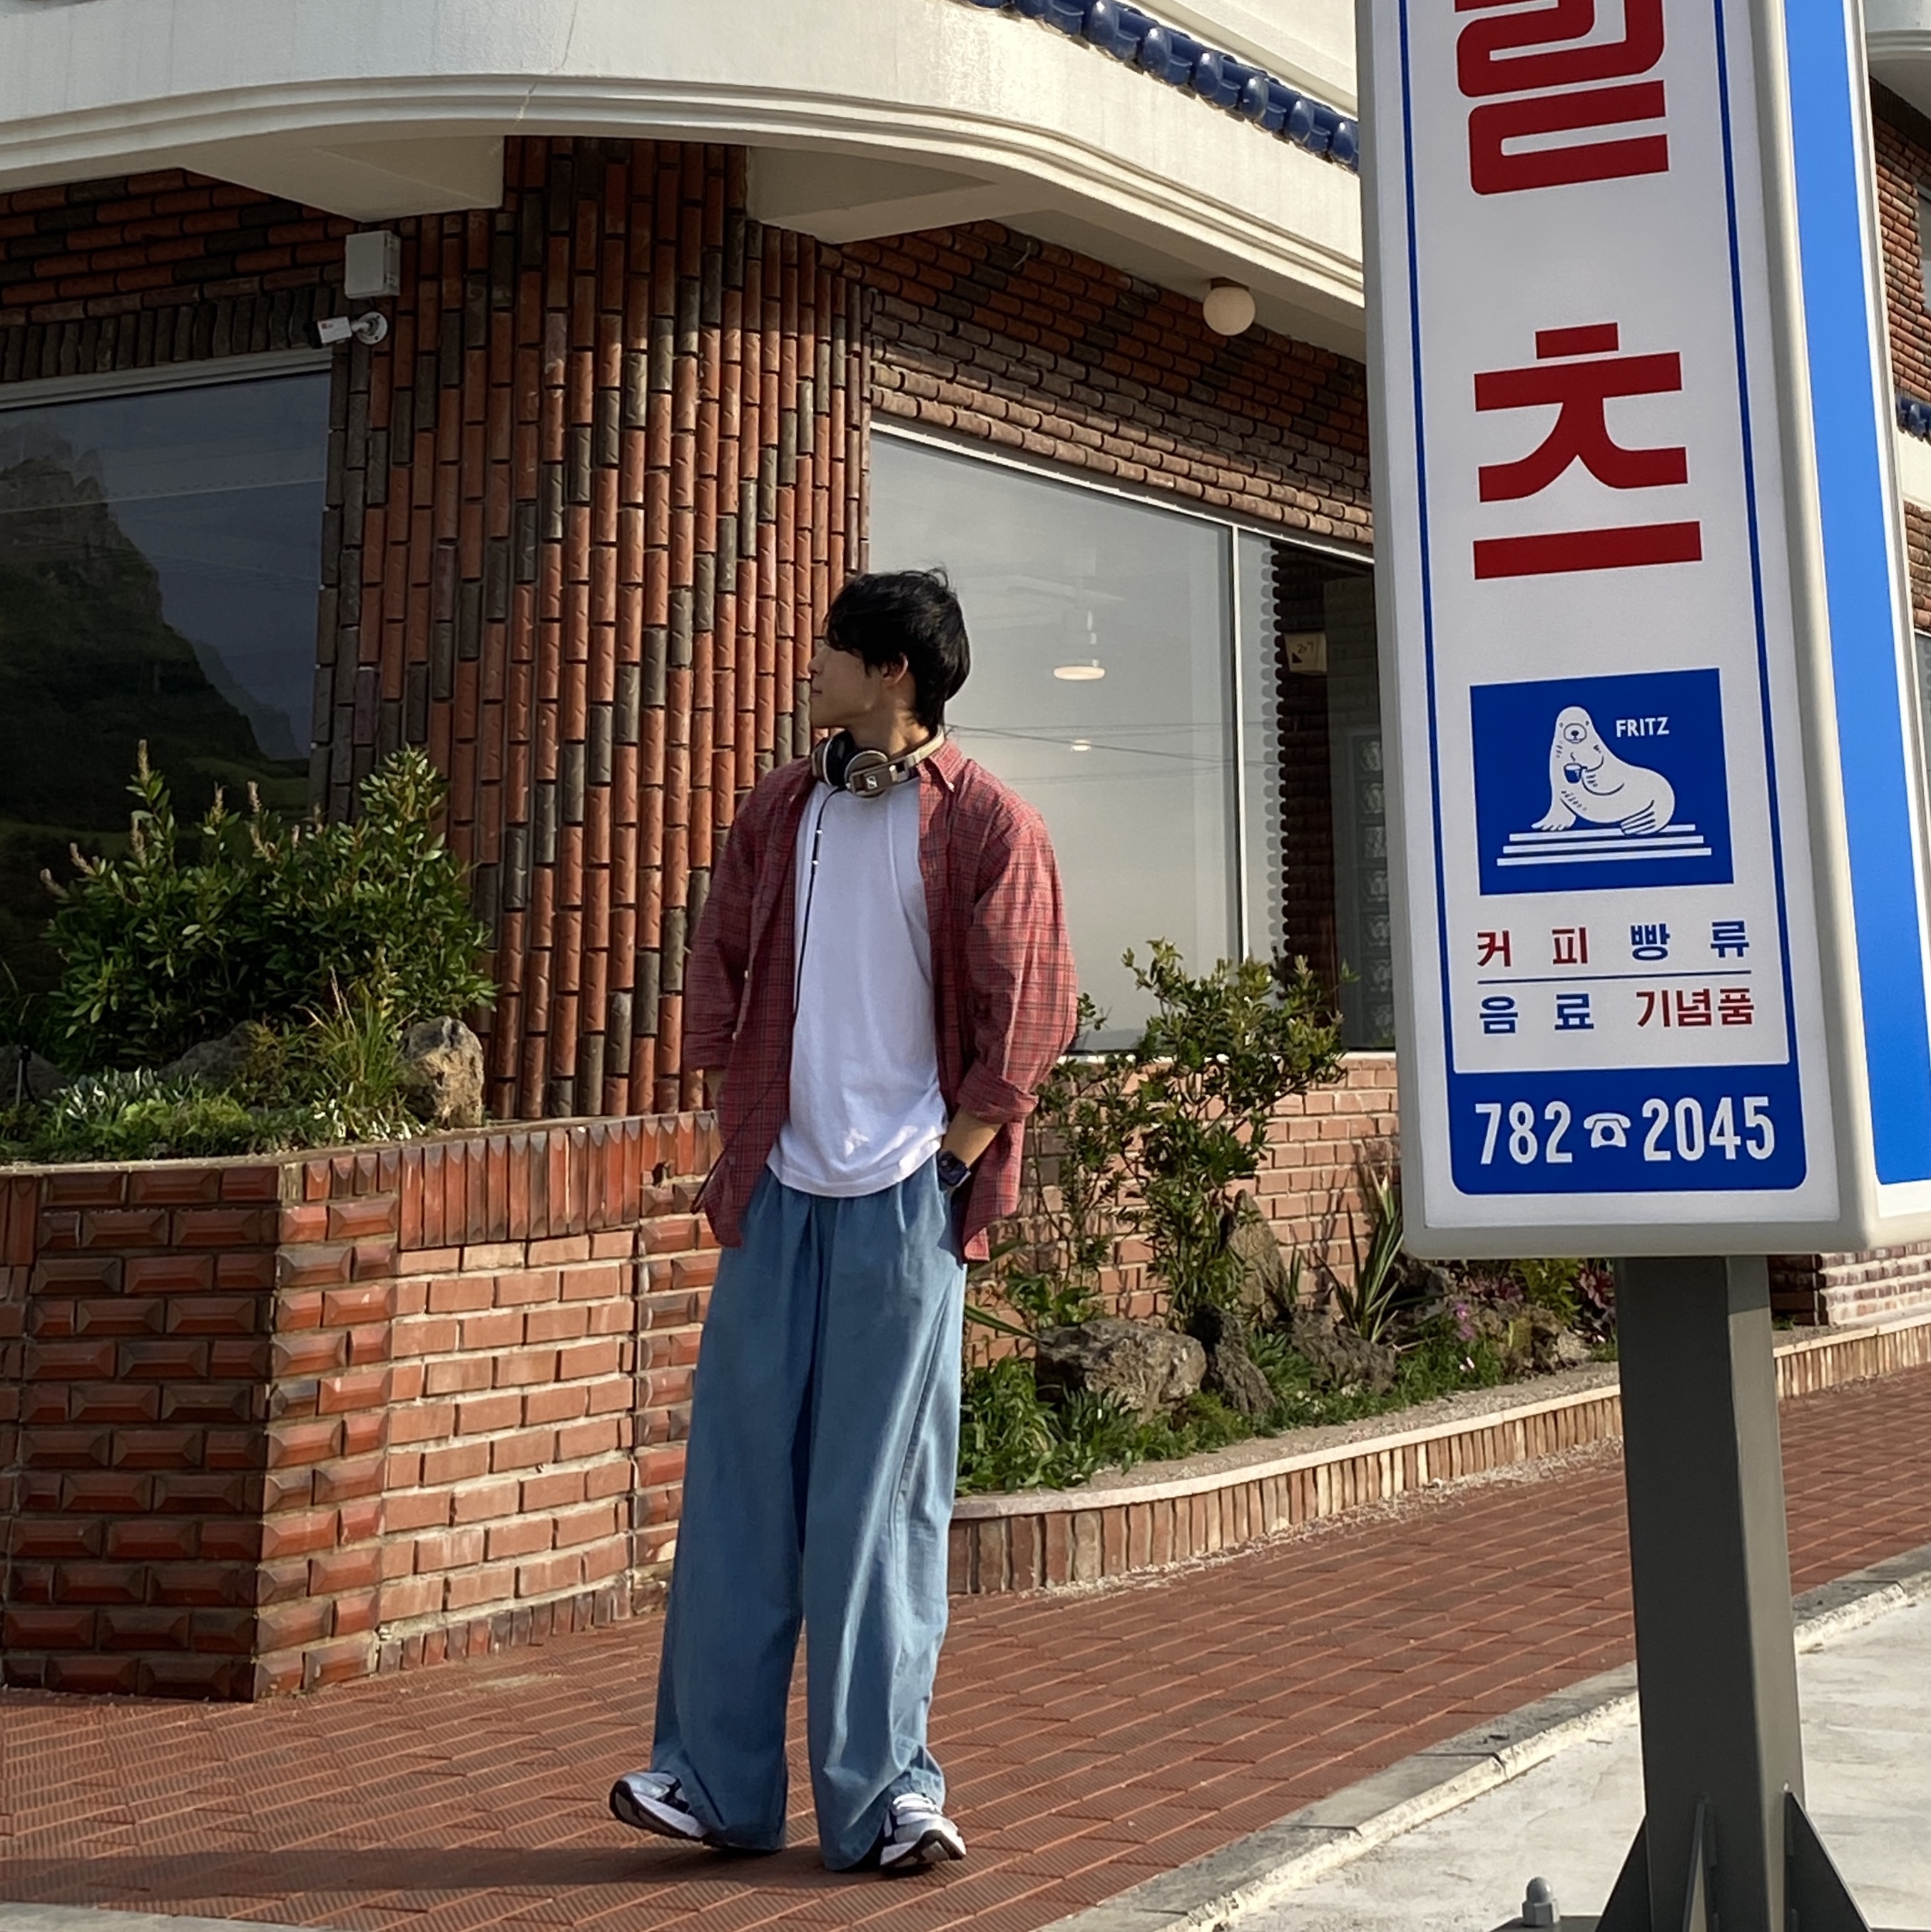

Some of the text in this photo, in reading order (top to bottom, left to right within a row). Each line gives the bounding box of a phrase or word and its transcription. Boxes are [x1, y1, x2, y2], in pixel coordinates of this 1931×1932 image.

[1616, 716, 1670, 738] FRITZ
[1636, 987, 1754, 1027] 기념품
[1474, 1097, 1775, 1165] 782 2045
